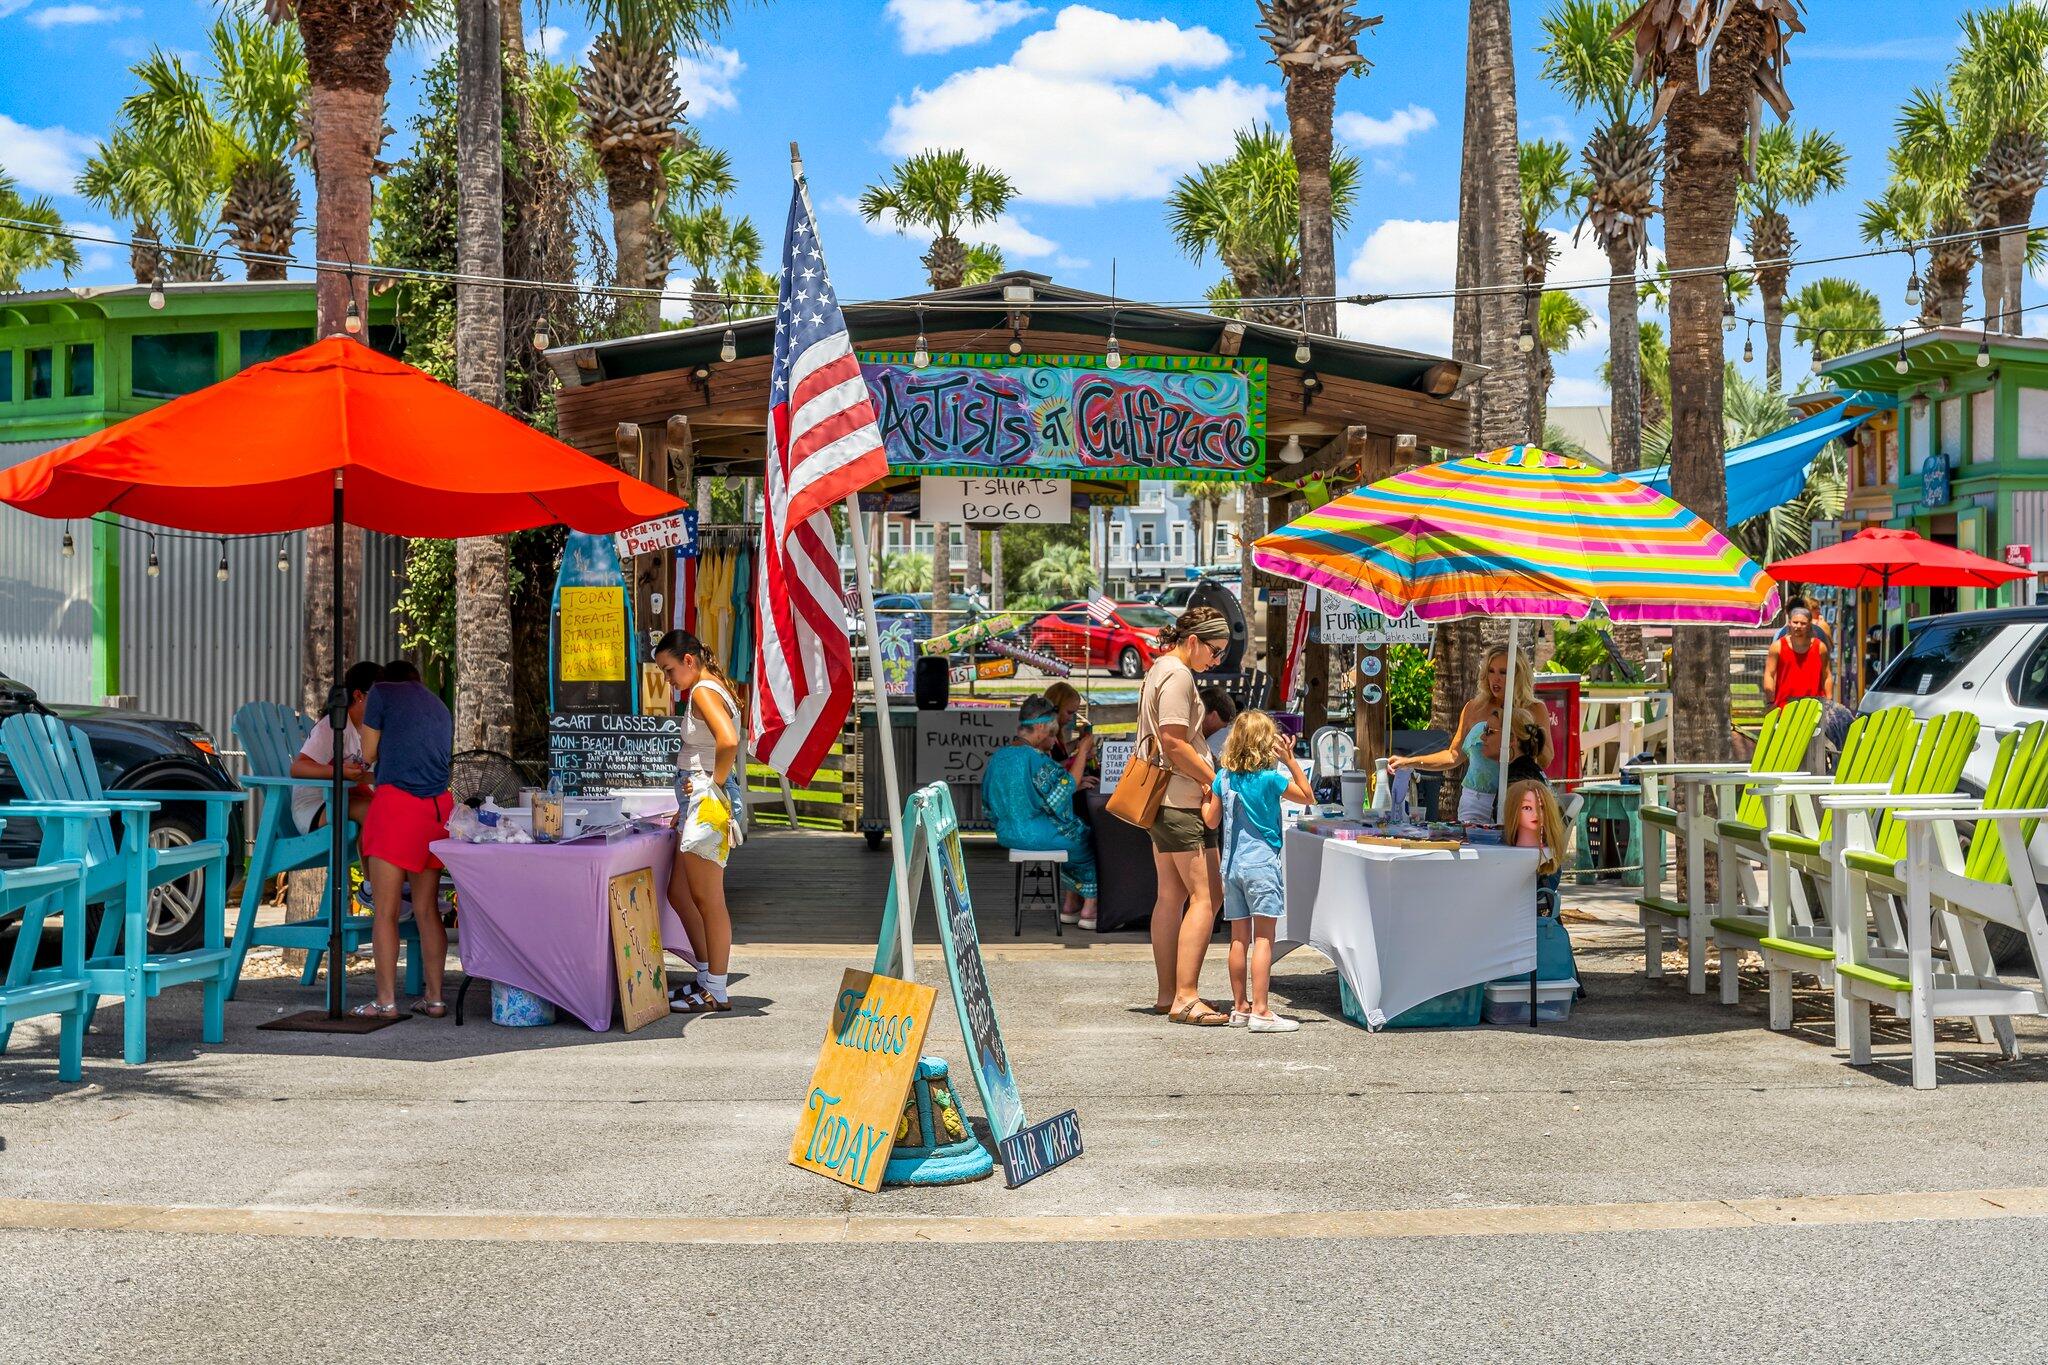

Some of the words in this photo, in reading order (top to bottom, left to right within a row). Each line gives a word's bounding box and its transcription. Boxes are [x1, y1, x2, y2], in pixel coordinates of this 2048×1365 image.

[957, 478, 1059, 496] T-SHIRTS
[962, 502, 1042, 520] BOGO
[662, 517, 681, 530] THE
[627, 532, 682, 556] PUBLIC
[565, 590, 616, 609] TODAY
[565, 611, 620, 627] CREATE
[563, 625, 622, 643] STARFISH
[564, 641, 623, 655] CHARACTERS
[564, 656, 622, 674] WORKSHOP
[568, 715, 596, 730] ART
[602, 715, 657, 731] CLASSES
[960, 711, 994, 727] ALL
[618, 735, 682, 753] ORNAMENTS
[926, 732, 1019, 748] FURNITUR
[1106, 746, 1134, 754] CREAT
[586, 762, 602, 770] DIY
[946, 774, 979, 782] OFF
[836, 988, 913, 1055] Tattoos
[1006, 1132, 1042, 1182] HAIR
[1043, 1112, 1081, 1165] WRAPS
